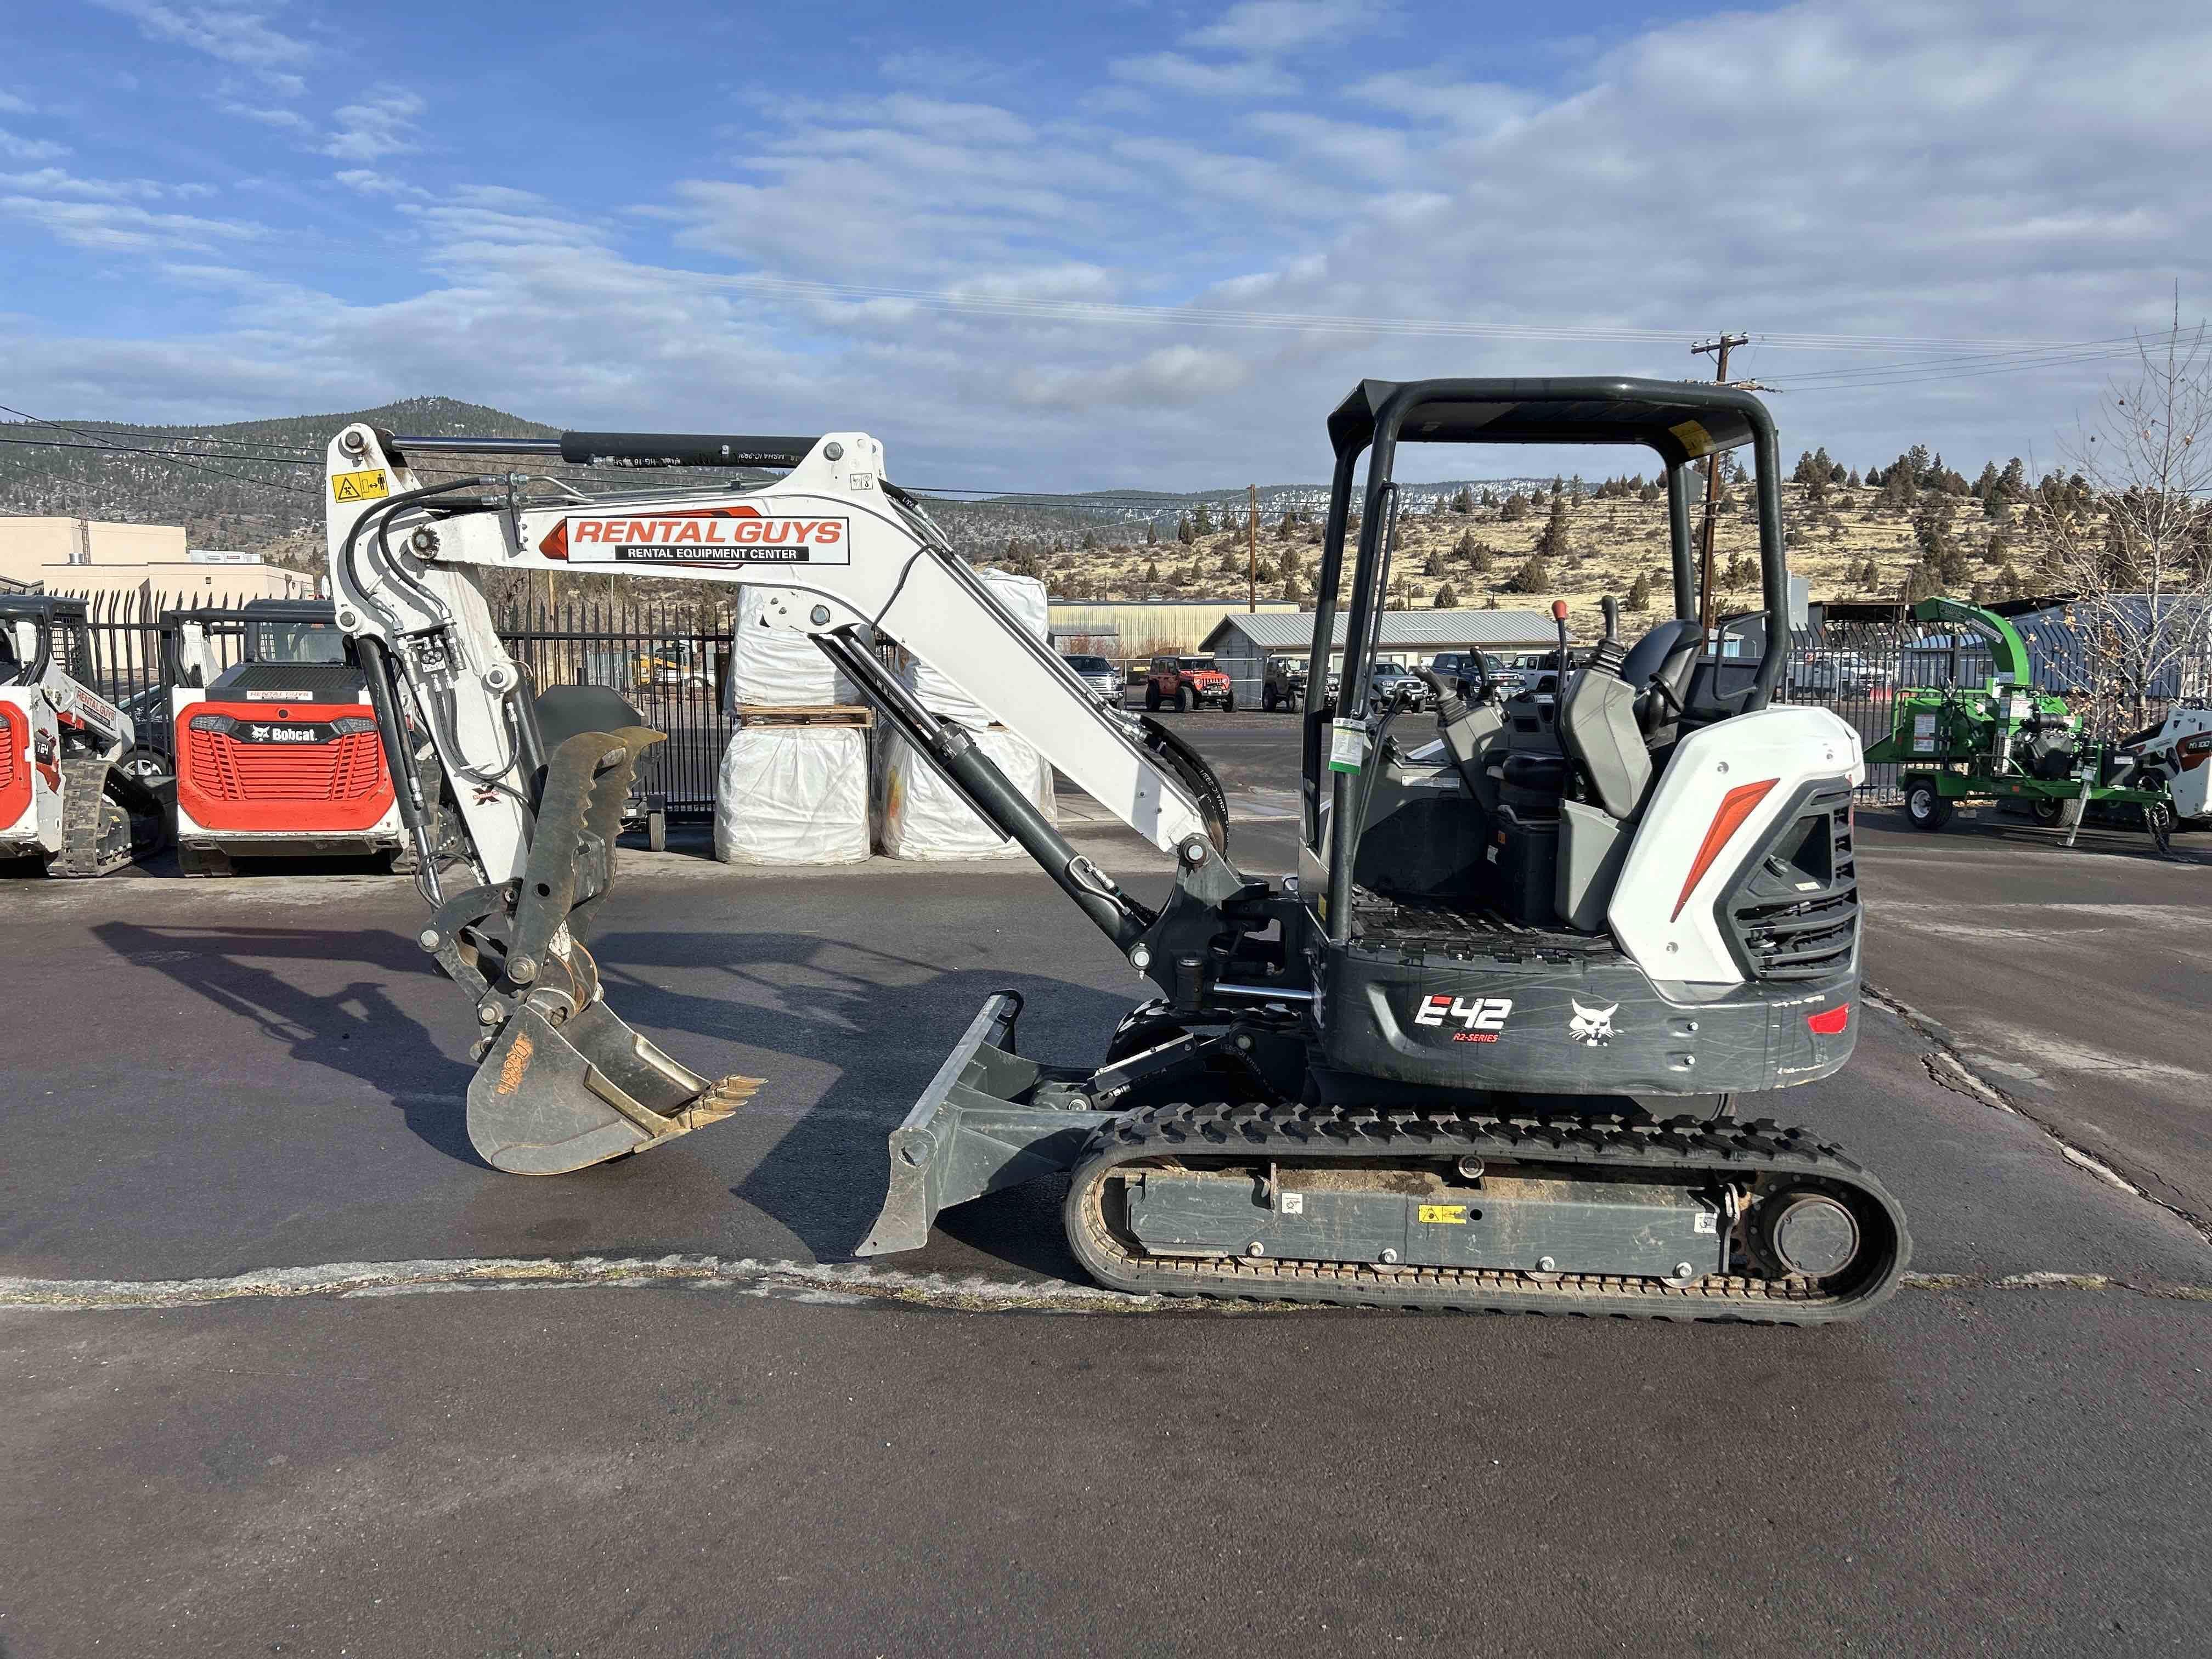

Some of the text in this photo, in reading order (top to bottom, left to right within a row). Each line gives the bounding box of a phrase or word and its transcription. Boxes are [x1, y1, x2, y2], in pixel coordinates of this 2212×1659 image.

[574, 521, 842, 543] RENTAL GUYS
[628, 548, 797, 559] RENTAL EQUIPMENT CENTER
[77, 690, 100, 712] RENTAL
[100, 705, 115, 721] GUYS
[1414, 995, 1513, 1029] E42
[1454, 1032, 1498, 1042] R2-SERIES
